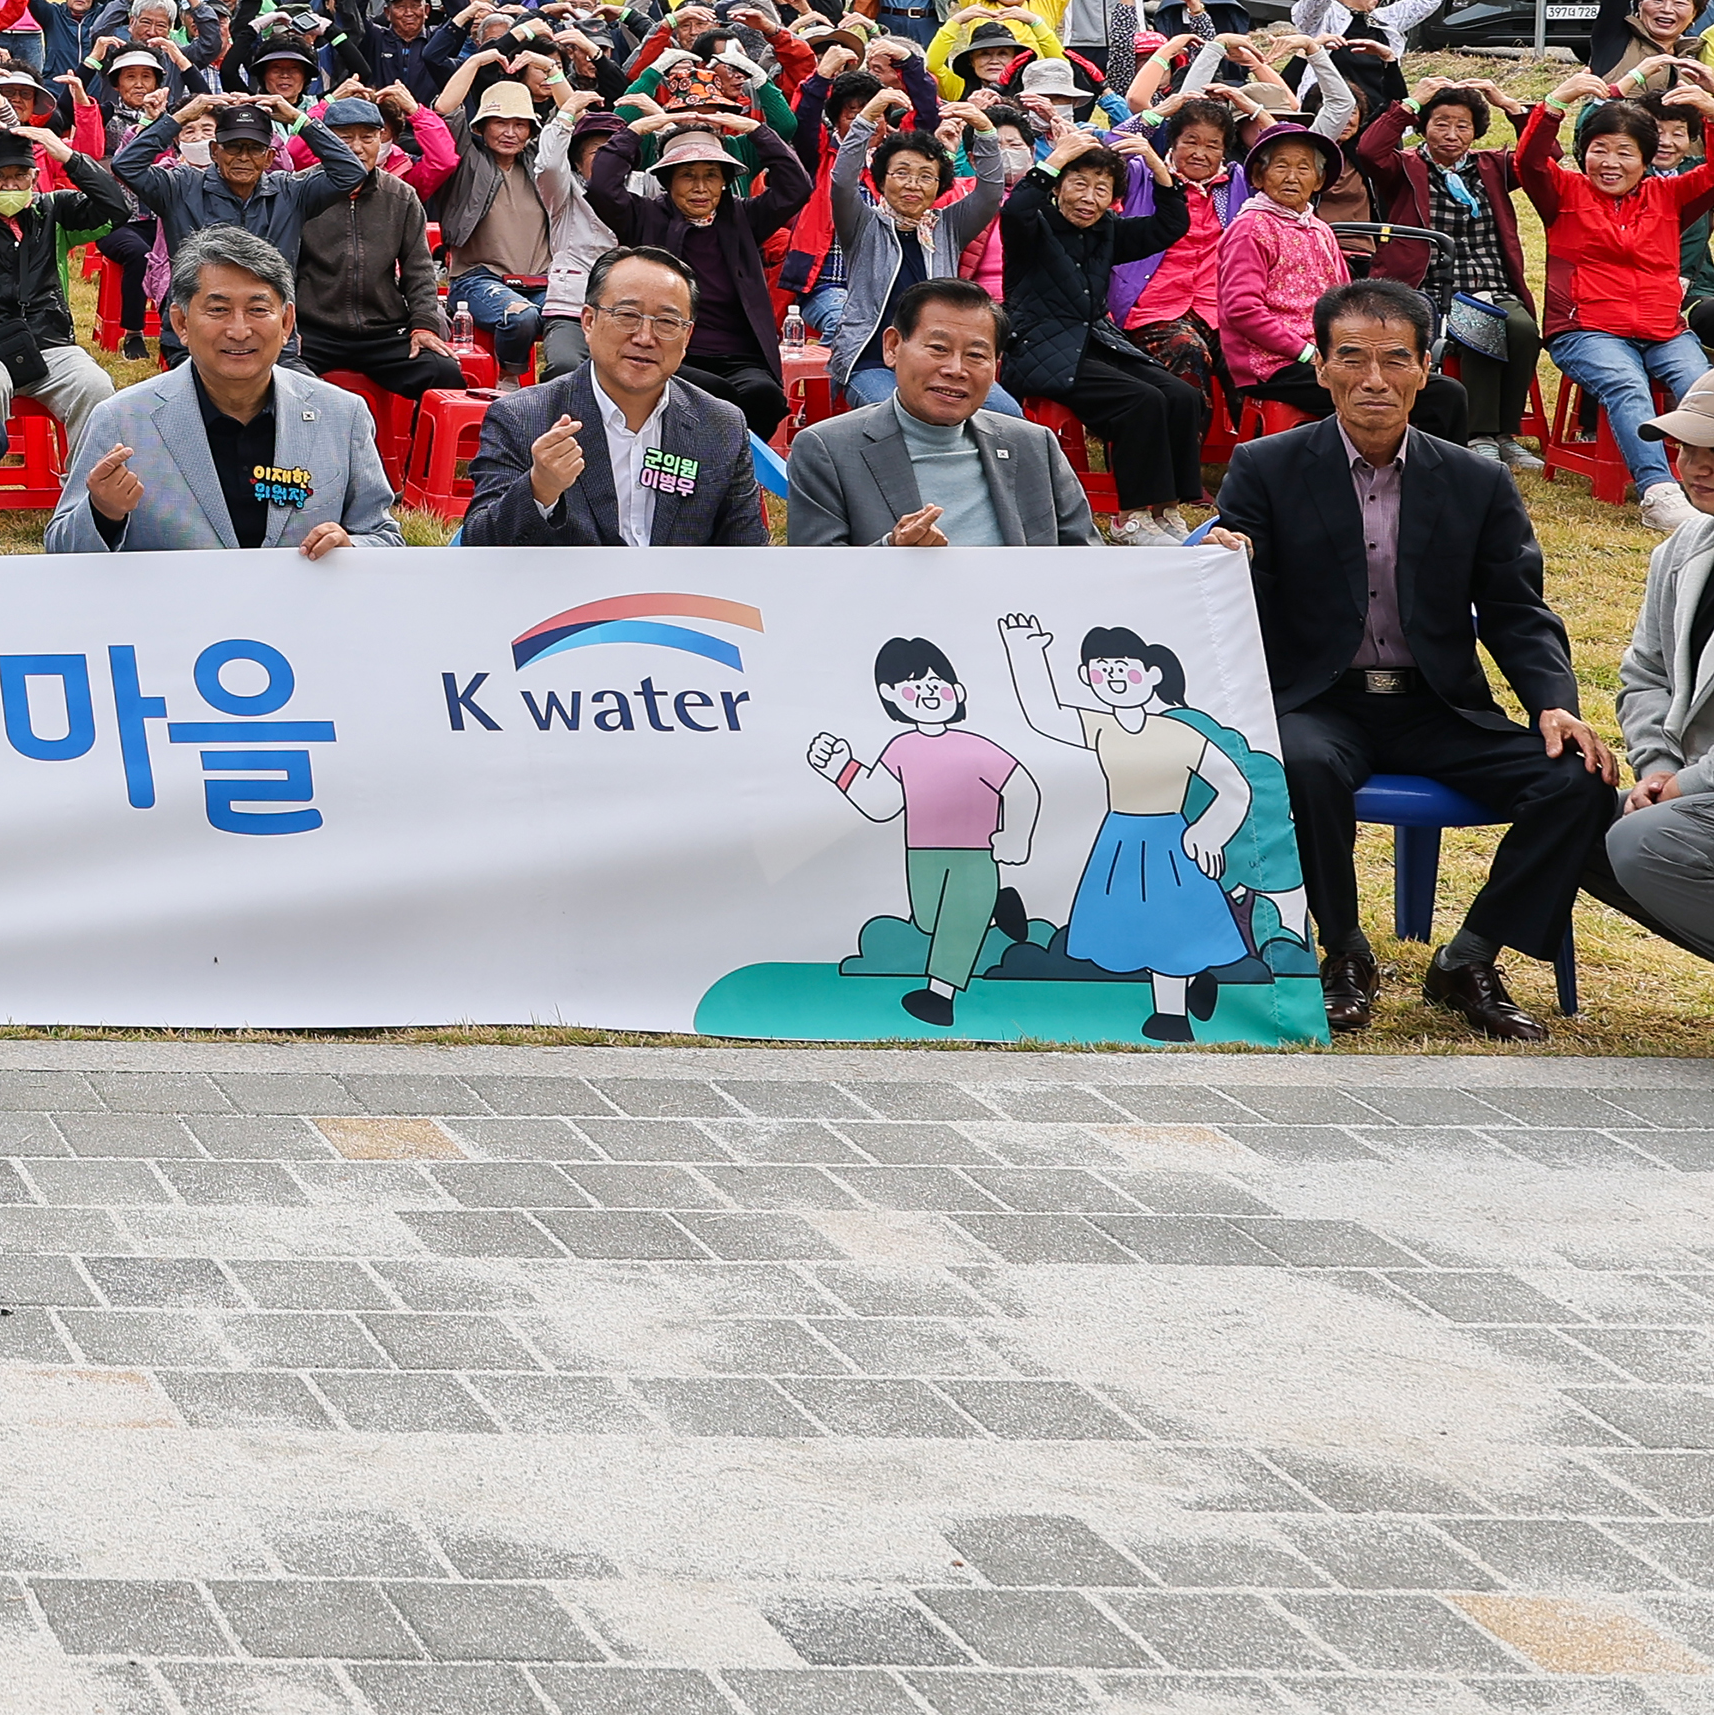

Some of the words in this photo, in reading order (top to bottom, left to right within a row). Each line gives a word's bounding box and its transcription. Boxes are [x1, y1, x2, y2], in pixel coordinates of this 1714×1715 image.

[253, 465, 311, 489] 이재한
[644, 448, 699, 480] 군의원
[254, 482, 308, 508] 위원장
[640, 468, 695, 497] 이병우
[440, 671, 504, 732] K
[519, 675, 752, 733] water
